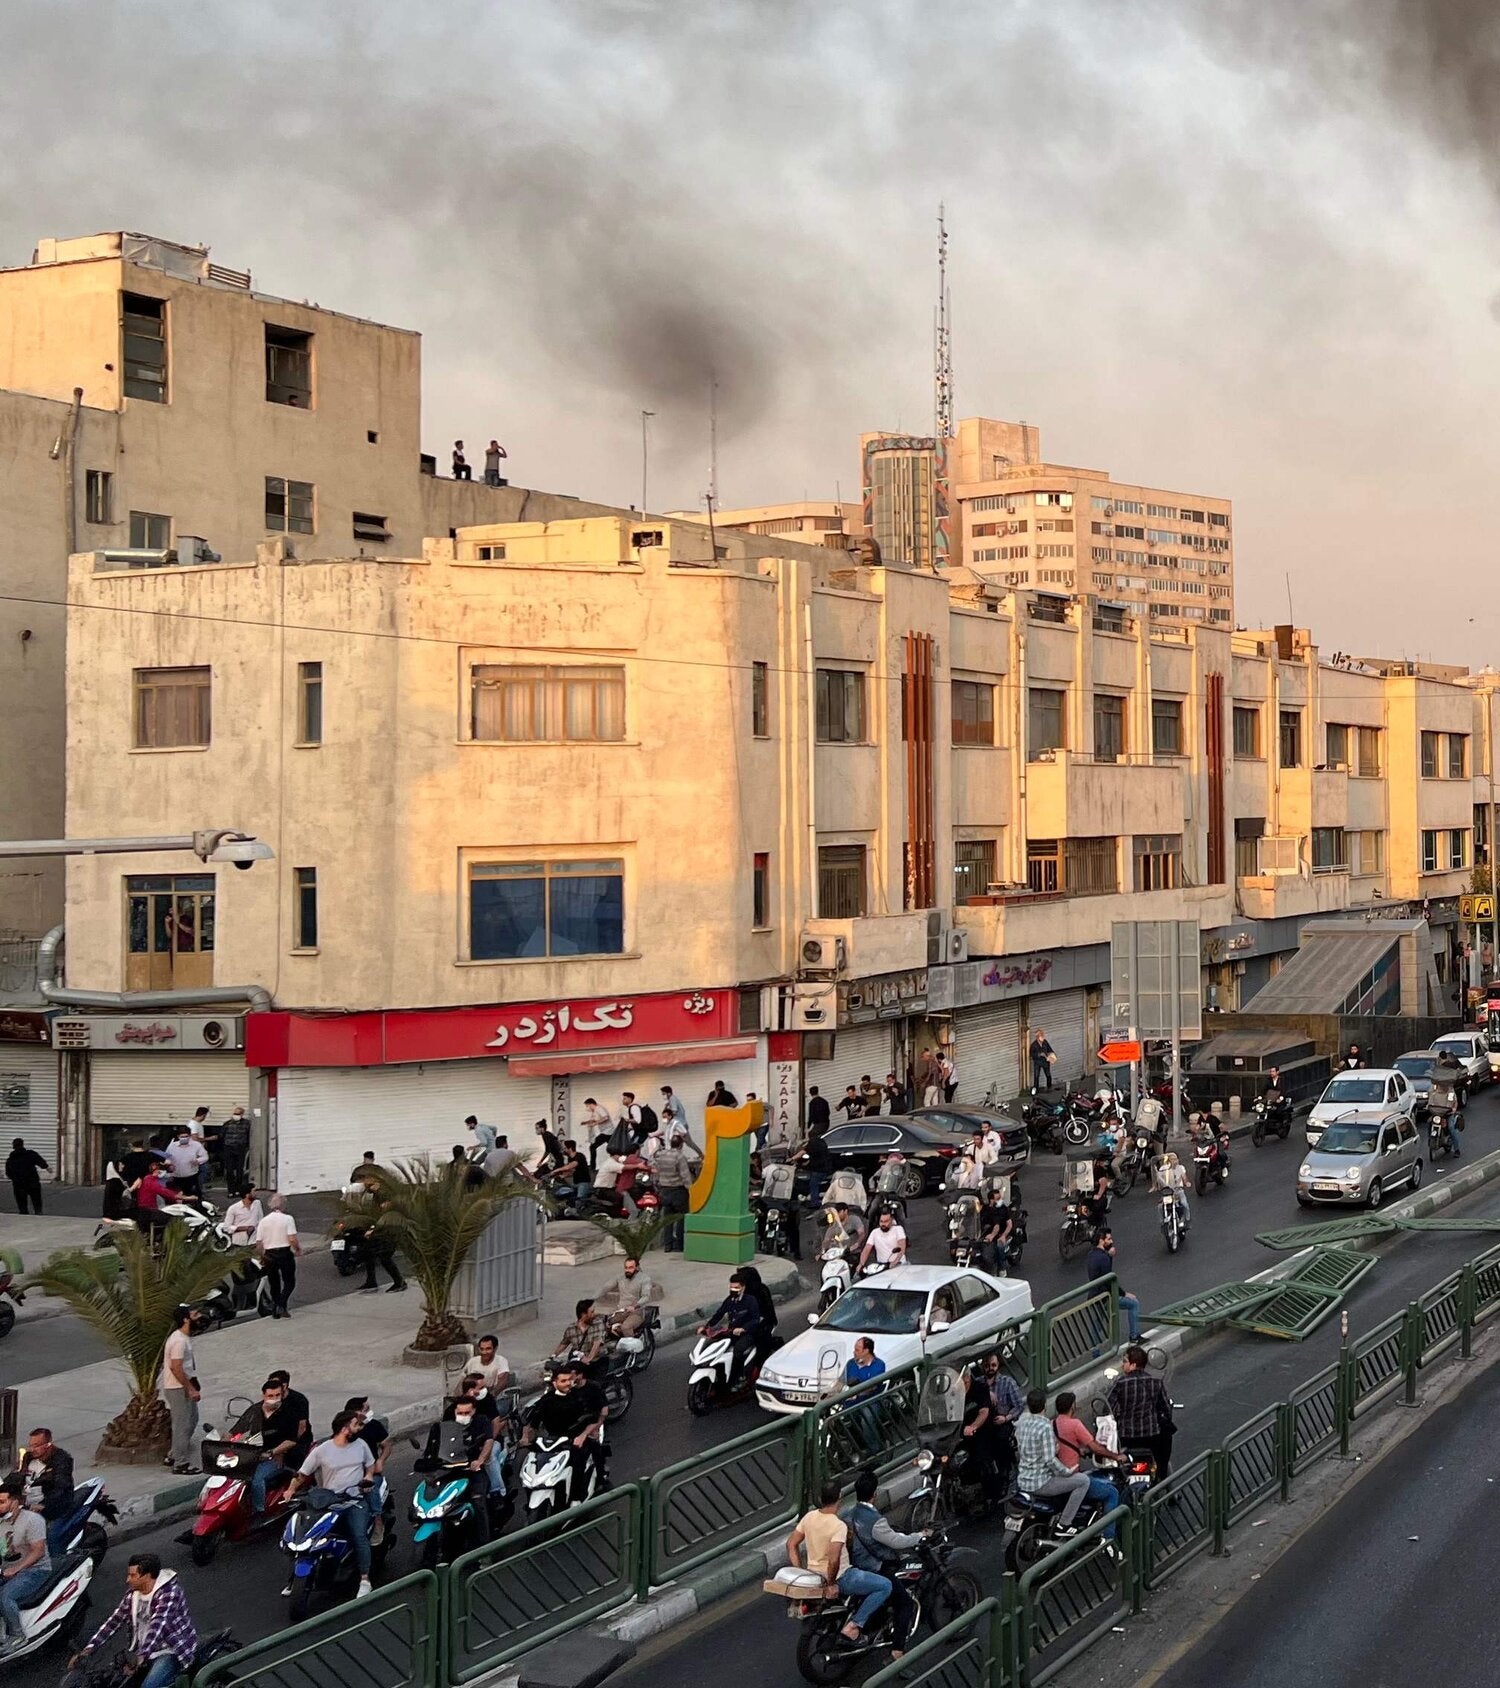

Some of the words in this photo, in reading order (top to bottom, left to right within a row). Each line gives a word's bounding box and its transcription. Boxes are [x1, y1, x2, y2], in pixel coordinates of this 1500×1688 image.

[573, 1002, 633, 1031] تک
[683, 992, 715, 1014] ویژه
[484, 1005, 570, 1046] اژدر
[557, 1091, 566, 1142] ZAPA
